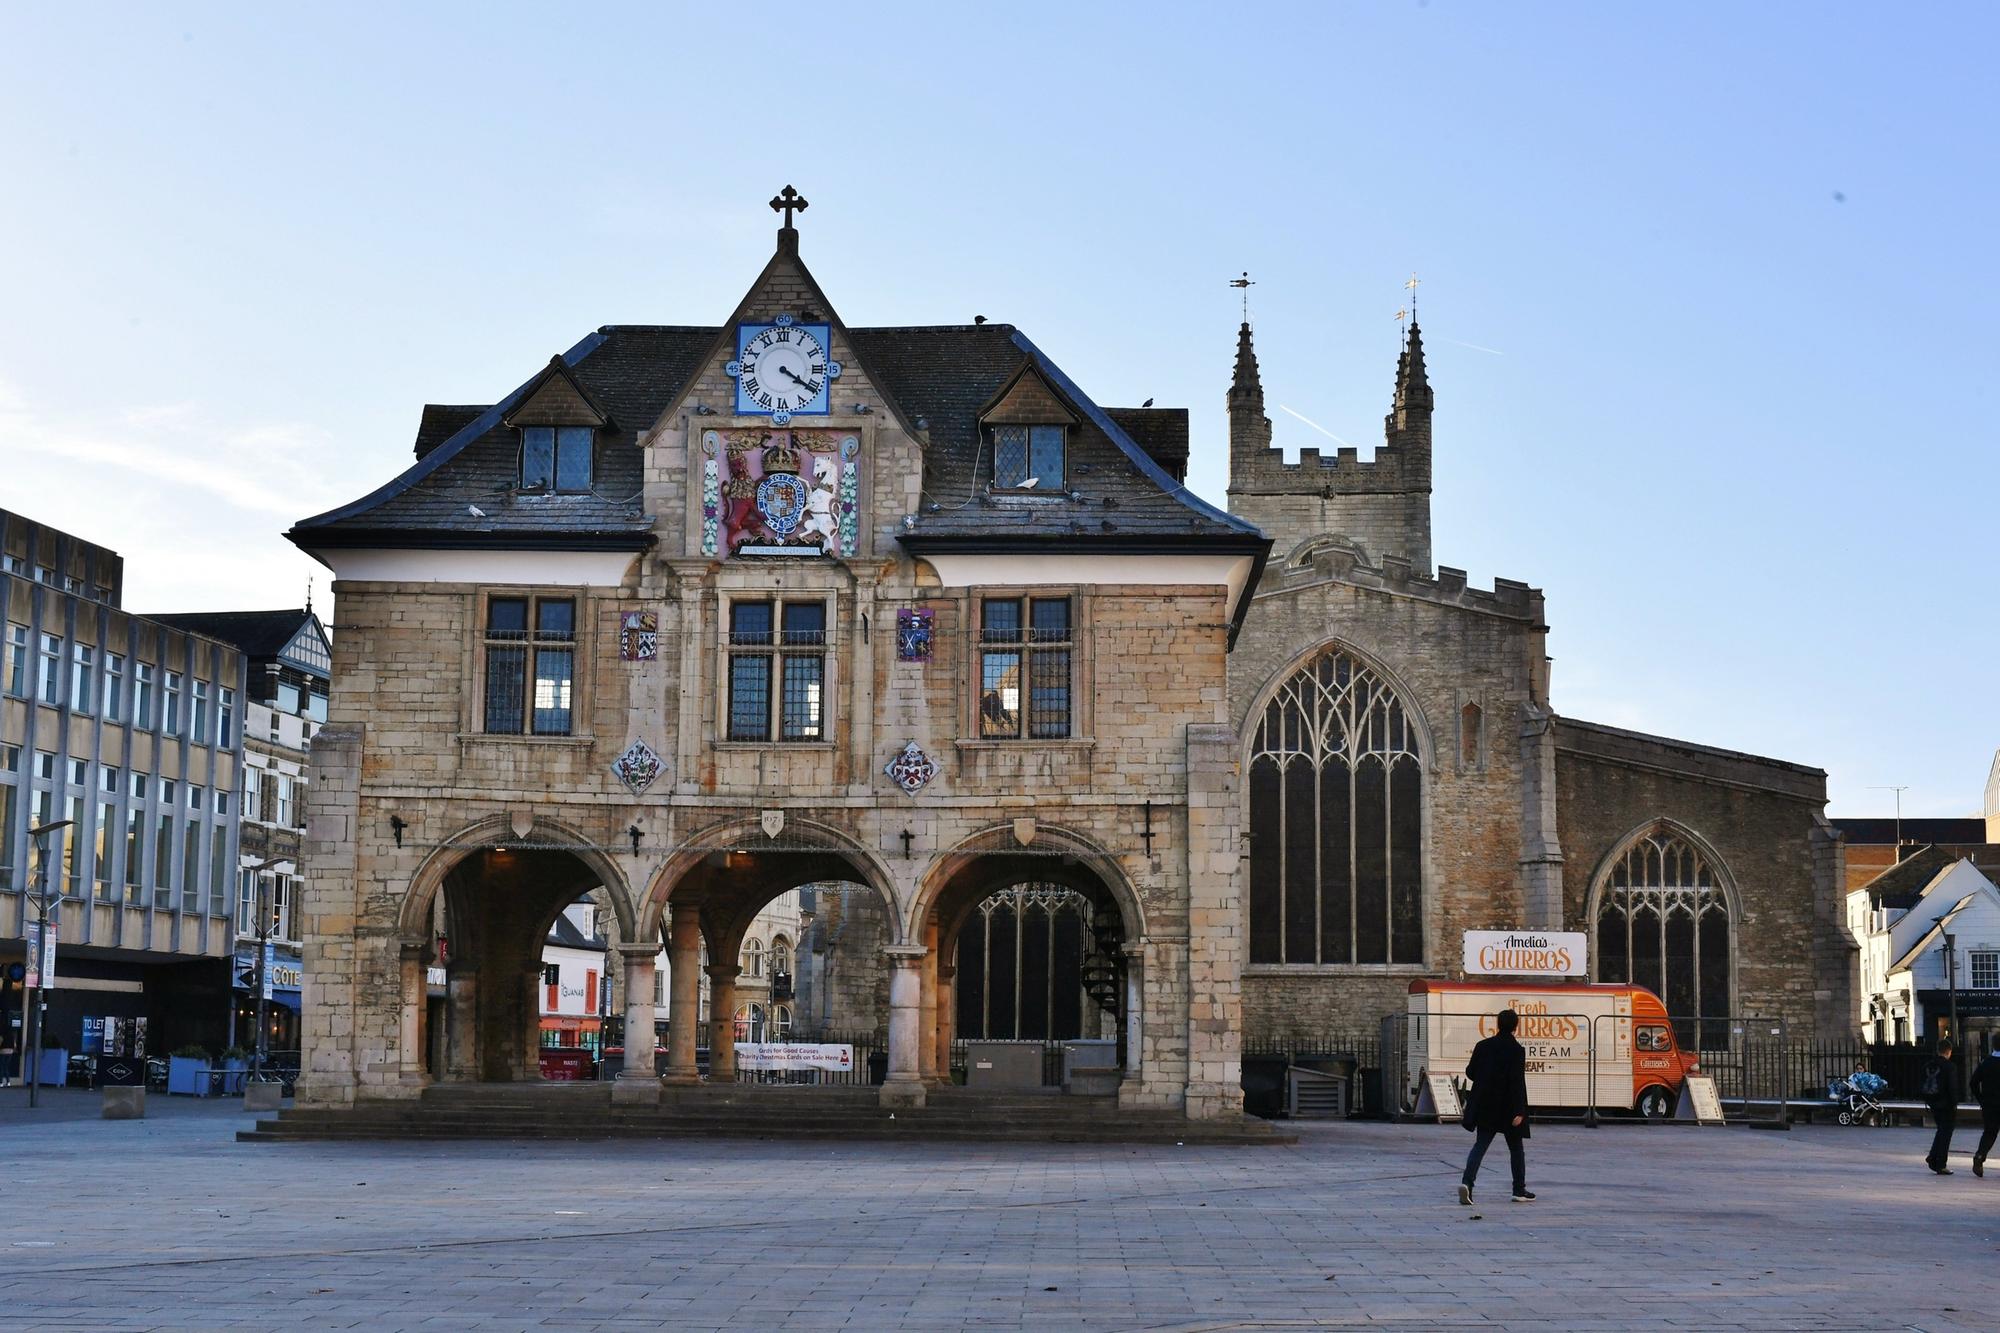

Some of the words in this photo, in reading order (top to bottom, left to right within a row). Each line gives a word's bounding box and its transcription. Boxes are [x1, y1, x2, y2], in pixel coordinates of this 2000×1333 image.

[777, 315, 791, 323] 60
[759, 334, 774, 349] XI
[775, 331, 791, 343] XII
[796, 335, 805, 347] I
[747, 347, 760, 360] X
[806, 347, 820, 359] II
[728, 364, 739, 373] 45
[743, 362, 756, 374] IX
[811, 364, 824, 375] III
[828, 365, 838, 374] 15
[745, 377, 760, 397] VIII
[758, 391, 773, 408] VII
[776, 397, 789, 410] VI
[797, 394, 807, 406] V
[776, 415, 788, 423] 30
[1503, 934, 1548, 949] Amelia's
[1479, 945, 1572, 973] CHURROS
[273, 965, 303, 985] CÔTE
[1507, 998, 1548, 1016] Fresh
[84, 1019, 92, 1029] TO
[93, 1020, 104, 1029] LET
[1478, 1012, 1578, 1041] CRROS
[1528, 1046, 1571, 1057] REAM
[1524, 1061, 1545, 1073] EAM
